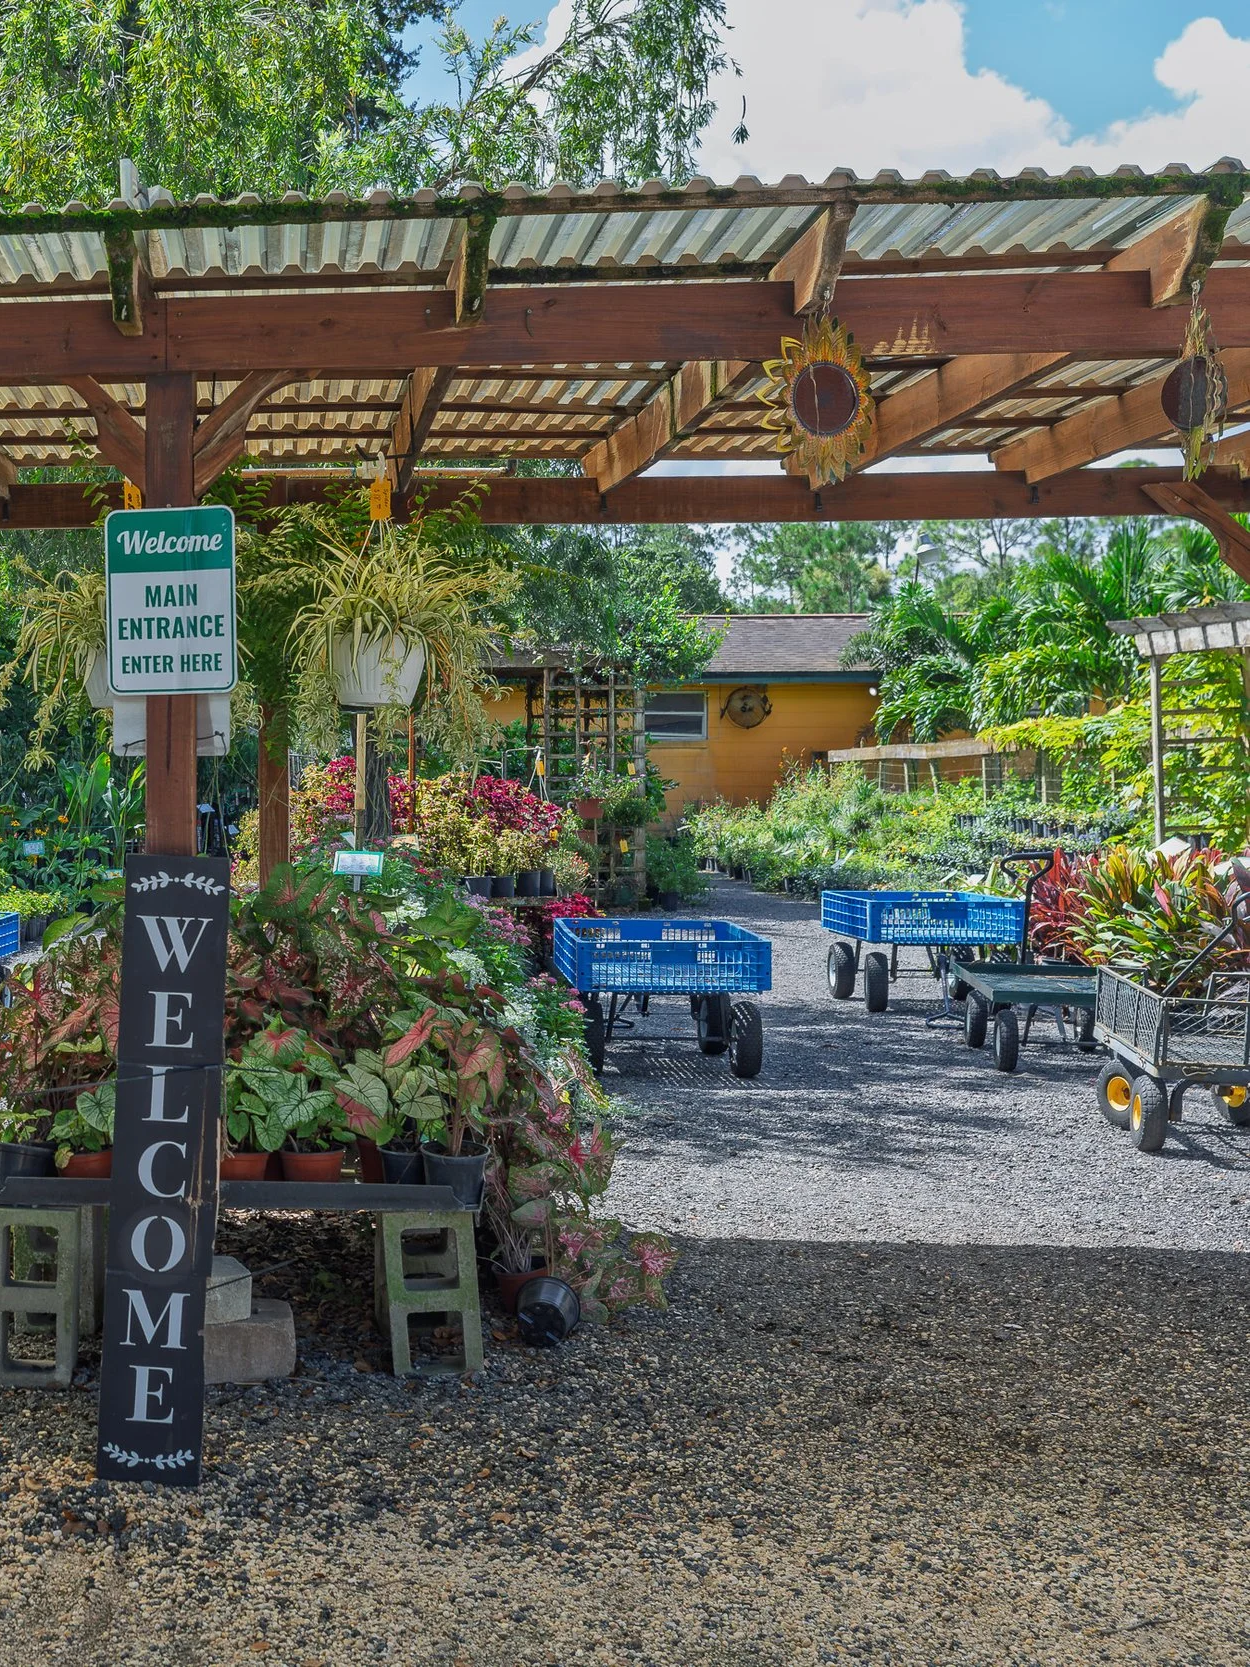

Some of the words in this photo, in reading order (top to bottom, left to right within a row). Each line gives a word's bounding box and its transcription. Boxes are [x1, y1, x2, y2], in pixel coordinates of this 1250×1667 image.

[116, 530, 223, 555] Welcome
[145, 583, 198, 608] MAIN
[118, 614, 225, 641] ENTRANCE
[122, 655, 174, 674] ENTER
[180, 653, 223, 673] HERE
[119, 914, 213, 1424] WELCOME
